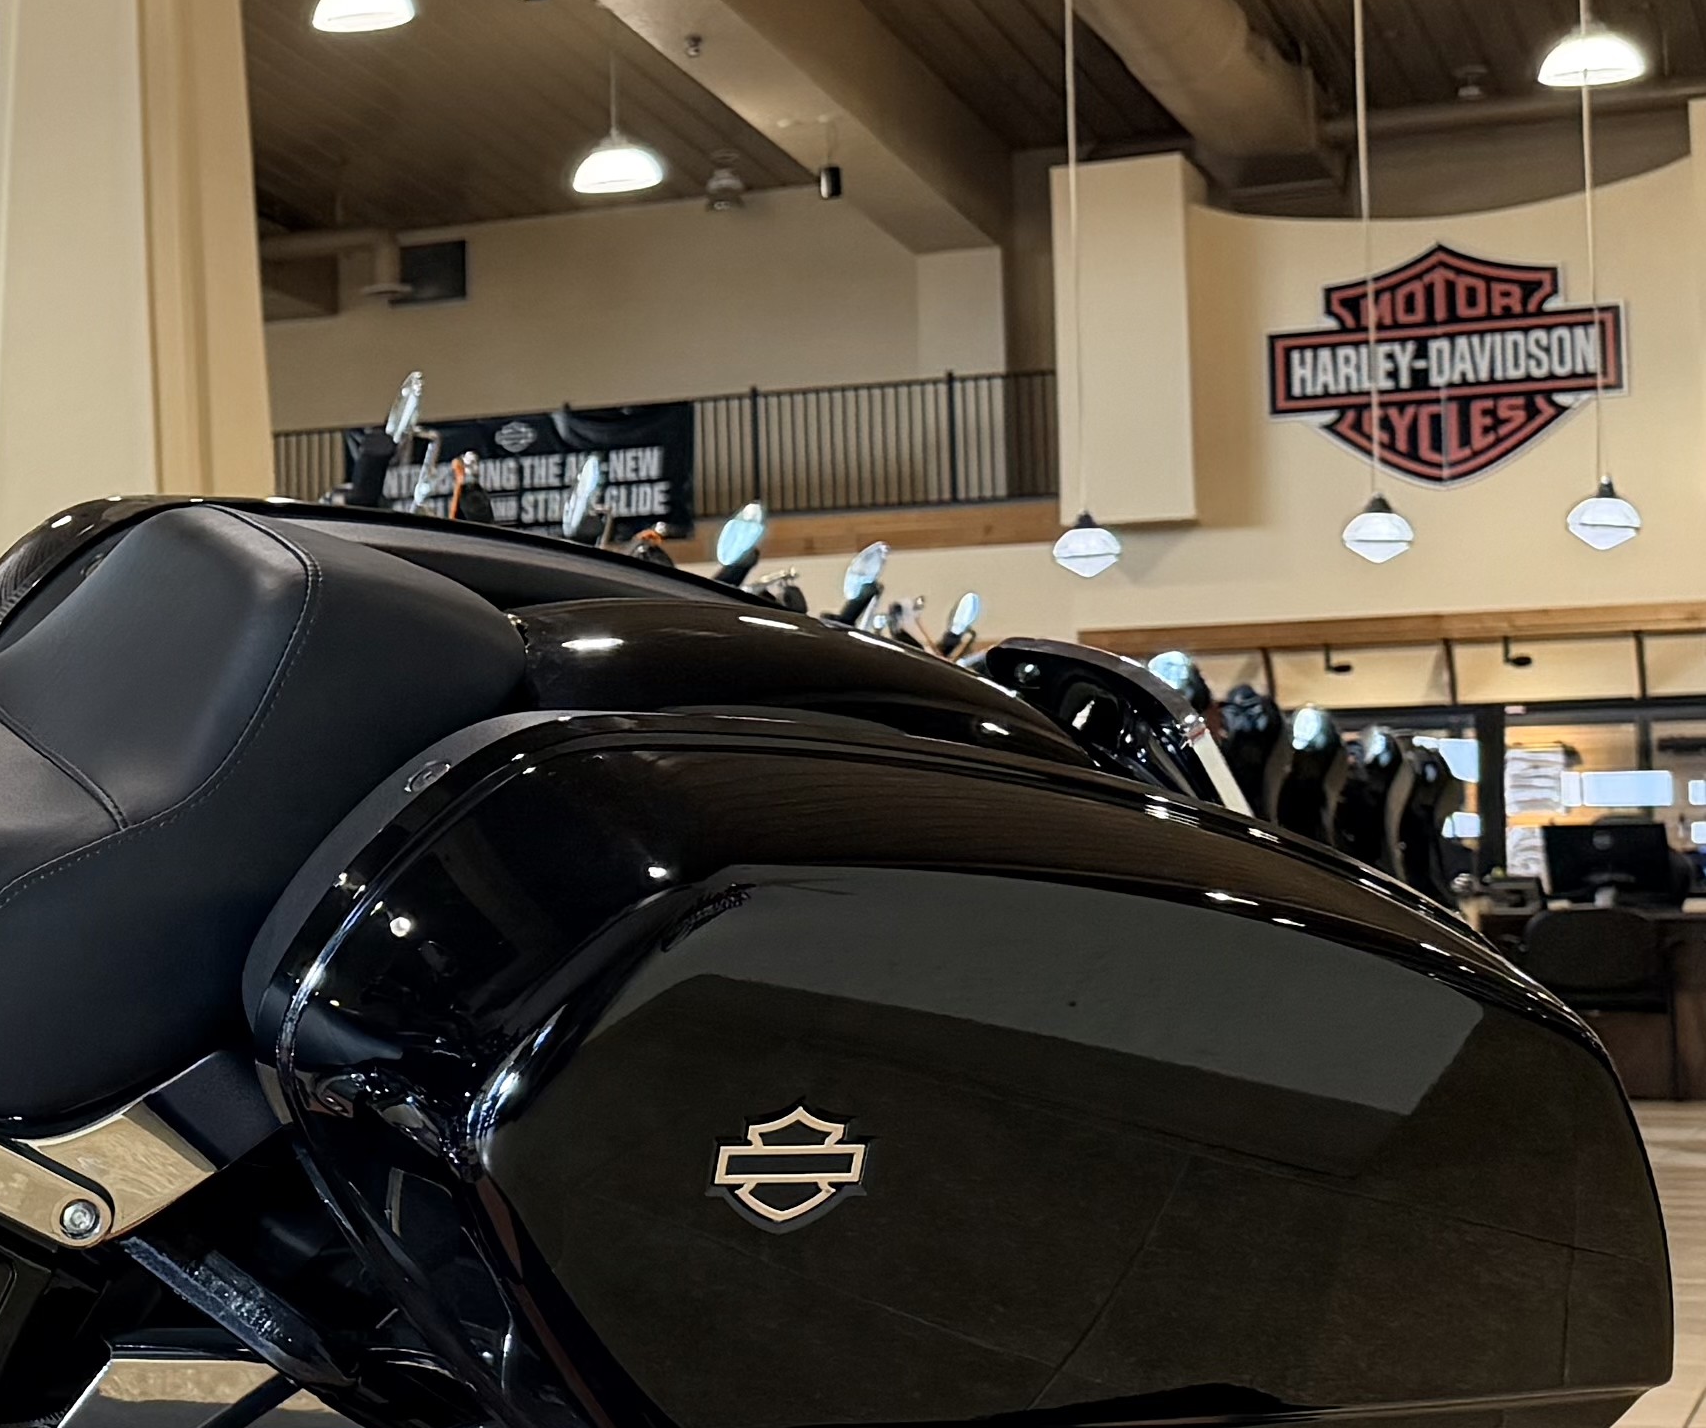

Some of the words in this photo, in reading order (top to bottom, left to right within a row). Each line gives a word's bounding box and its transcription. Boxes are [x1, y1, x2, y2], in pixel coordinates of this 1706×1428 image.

[1360, 270, 1523, 326] MOTOR
[1289, 324, 1597, 398] HARLEY-DAVIDSON
[1361, 395, 1528, 465] CYCLES
[520, 454, 563, 488] THE
[565, 446, 664, 484] A-NEW
